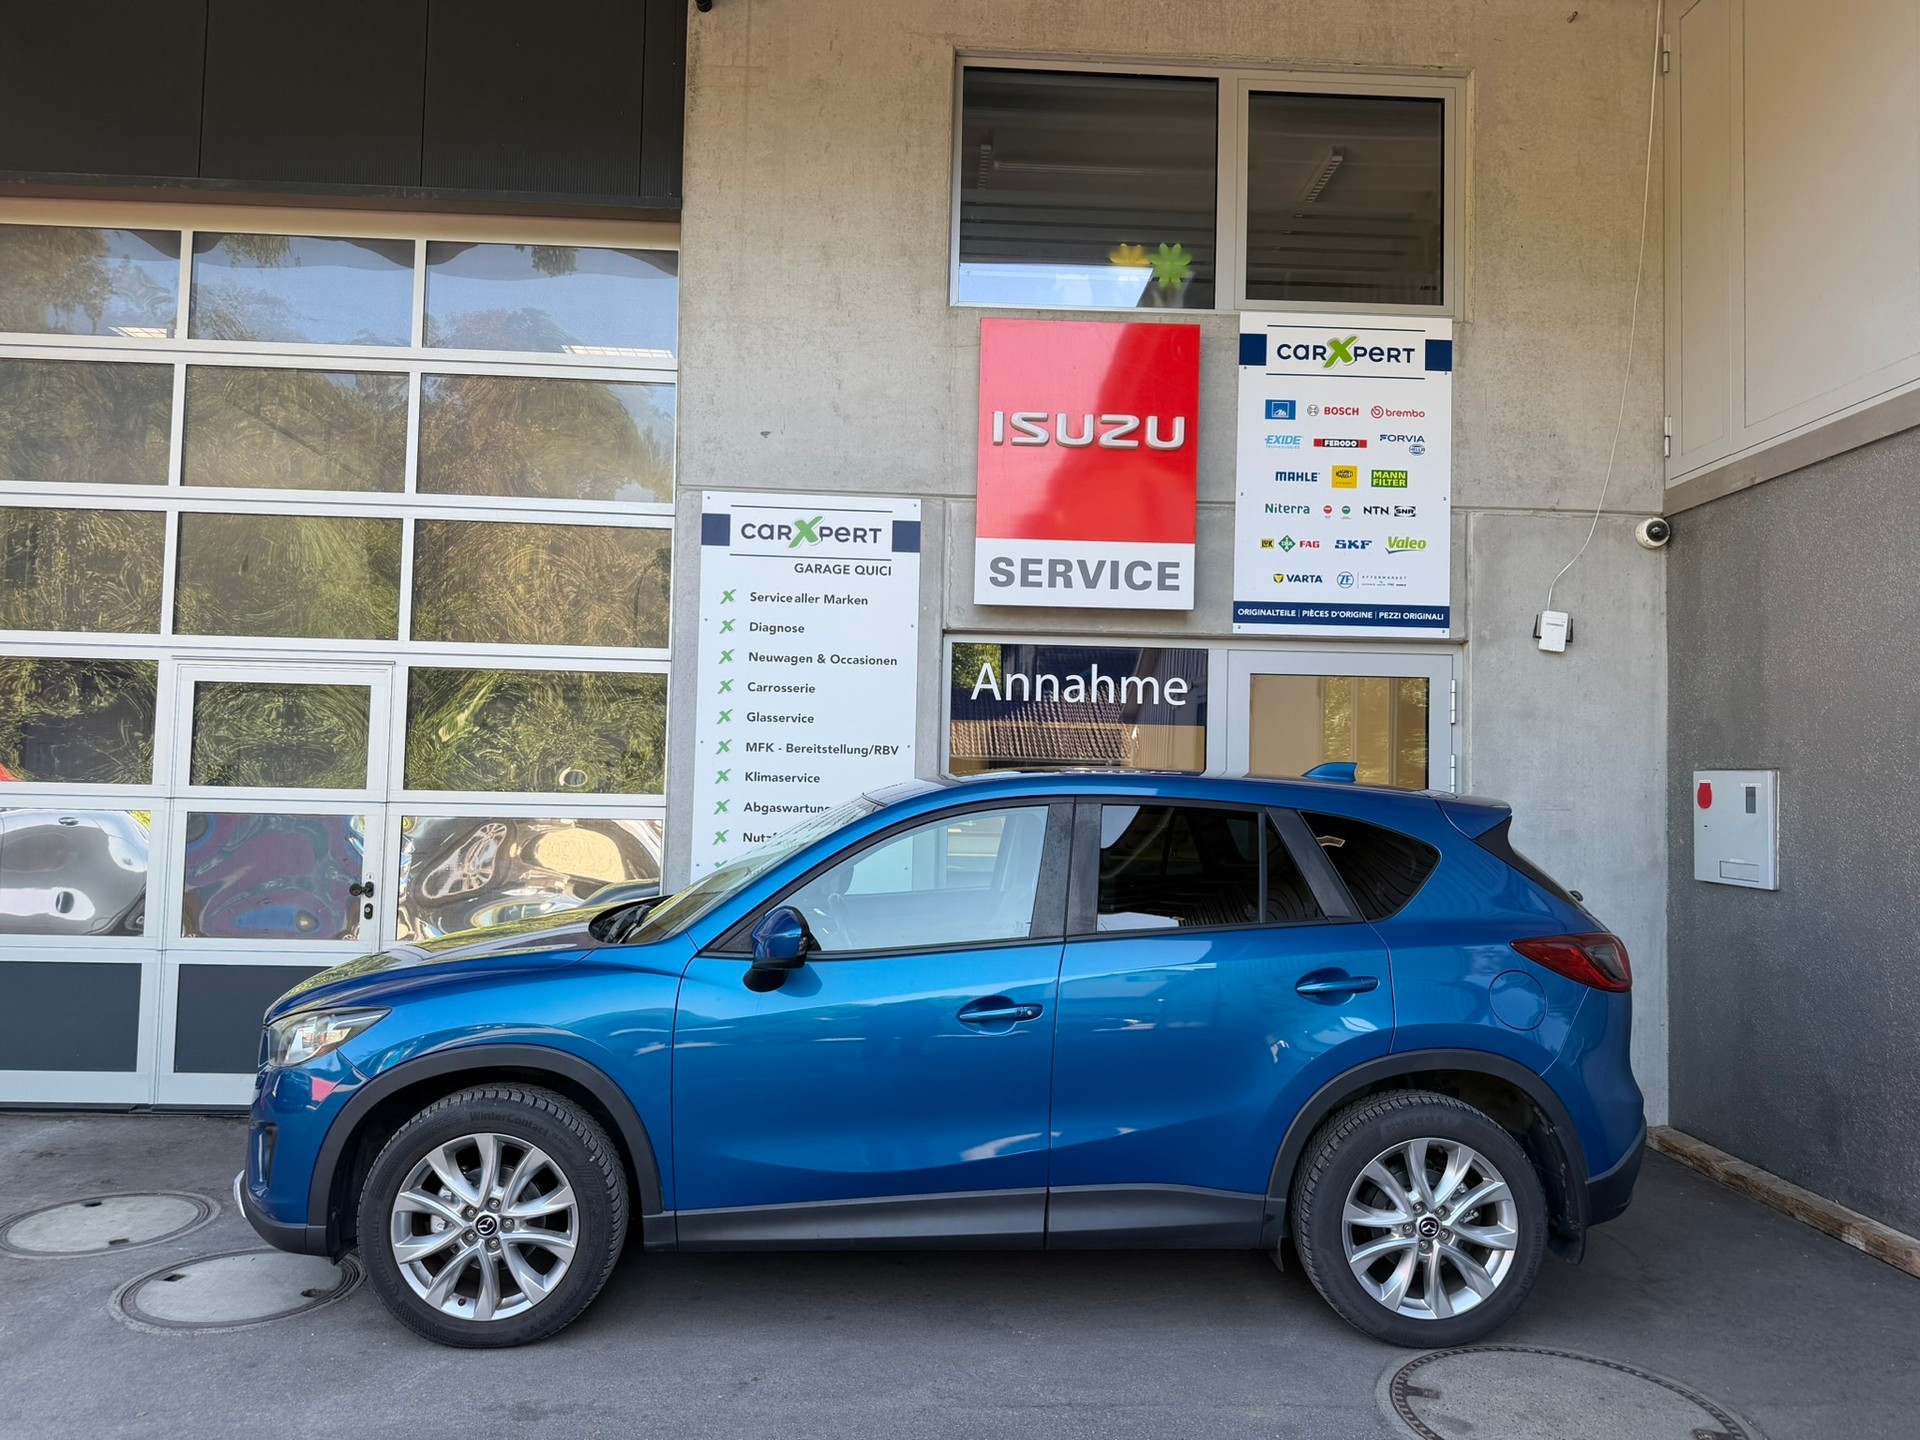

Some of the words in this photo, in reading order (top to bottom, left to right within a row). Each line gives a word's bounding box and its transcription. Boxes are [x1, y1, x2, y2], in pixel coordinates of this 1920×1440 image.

[1323, 406, 1360, 416] BOSCH
[1385, 408, 1426, 418] brembo
[991, 410, 1186, 450] ISUZU
[1265, 435, 1302, 445] EXIDE
[1324, 439, 1358, 448] FERODO
[1379, 434, 1426, 443] FORVIA
[1275, 471, 1318, 482] MAHLE
[1373, 471, 1406, 479] MANN
[1373, 479, 1406, 487] FILTER
[1265, 503, 1310, 515] Niterra
[1363, 506, 1389, 515] NTN
[1395, 507, 1415, 515] SNR
[1299, 540, 1320, 548] FAG
[1334, 539, 1373, 550] SKF
[1387, 536, 1427, 550] Valeo
[794, 563, 850, 575] GARAGE
[854, 565, 892, 577] QUICI
[988, 556, 1181, 591] SERVICE
[1286, 574, 1323, 584] VARTA
[749, 592, 793, 603] Service
[794, 593, 820, 604] aller
[823, 594, 868, 605] Marken
[1237, 608, 1297, 617] ORIGINALTEILE
[1301, 607, 1329, 618] PIÈCES
[1331, 609, 1373, 619] D'ORIGINE
[1378, 611, 1401, 620] PEZZI
[1402, 611, 1444, 621] ORIGINALI
[749, 622, 805, 636] Diagnose
[748, 652, 813, 666] Neuwagen
[816, 654, 827, 664] &
[830, 654, 898, 666] Occasionen
[747, 681, 816, 694] Carrosserie
[970, 661, 1188, 706] Annahme
[746, 711, 815, 724] Glasservice
[745, 742, 774, 753] MFK
[785, 743, 899, 758] Bereitstellung/RBV
[744, 771, 821, 783] Klimaservice
